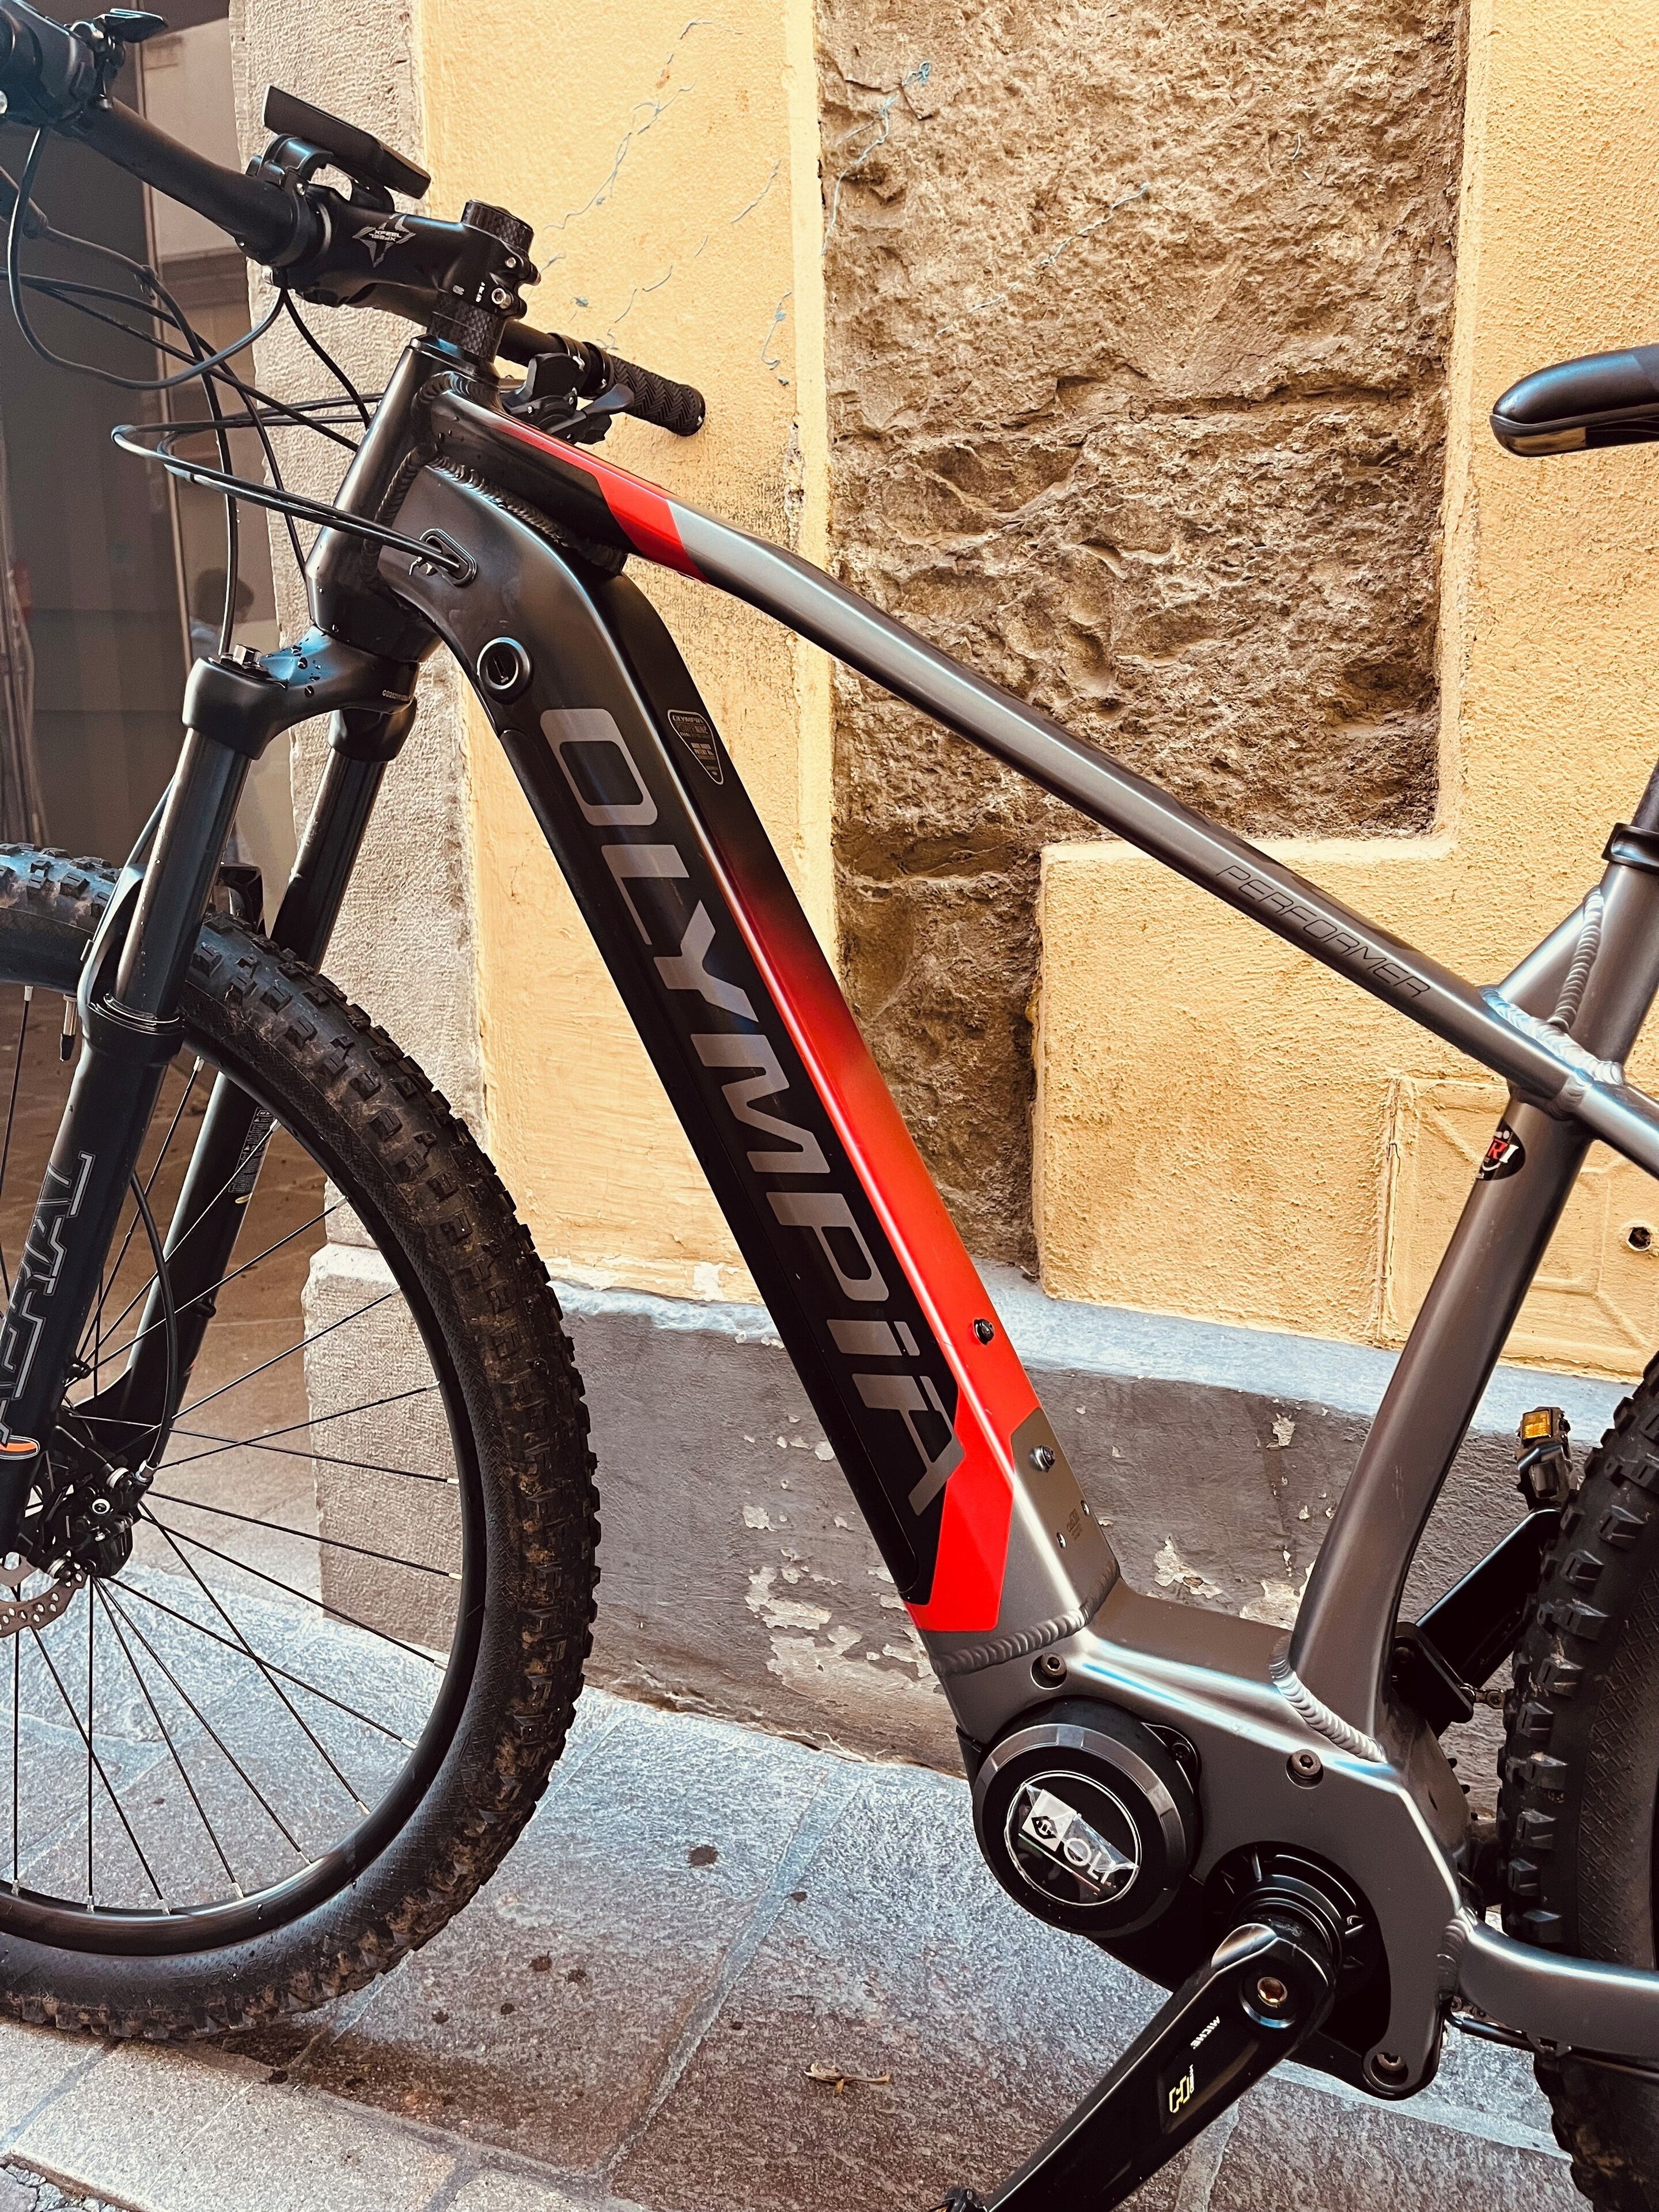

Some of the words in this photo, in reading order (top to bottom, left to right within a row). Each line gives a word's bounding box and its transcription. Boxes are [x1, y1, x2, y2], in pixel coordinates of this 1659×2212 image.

[1215, 865, 1431, 998] PERFORMER
[540, 708, 964, 1516] OLYMPIA
[1190, 2016, 1220, 2050] MICHE
